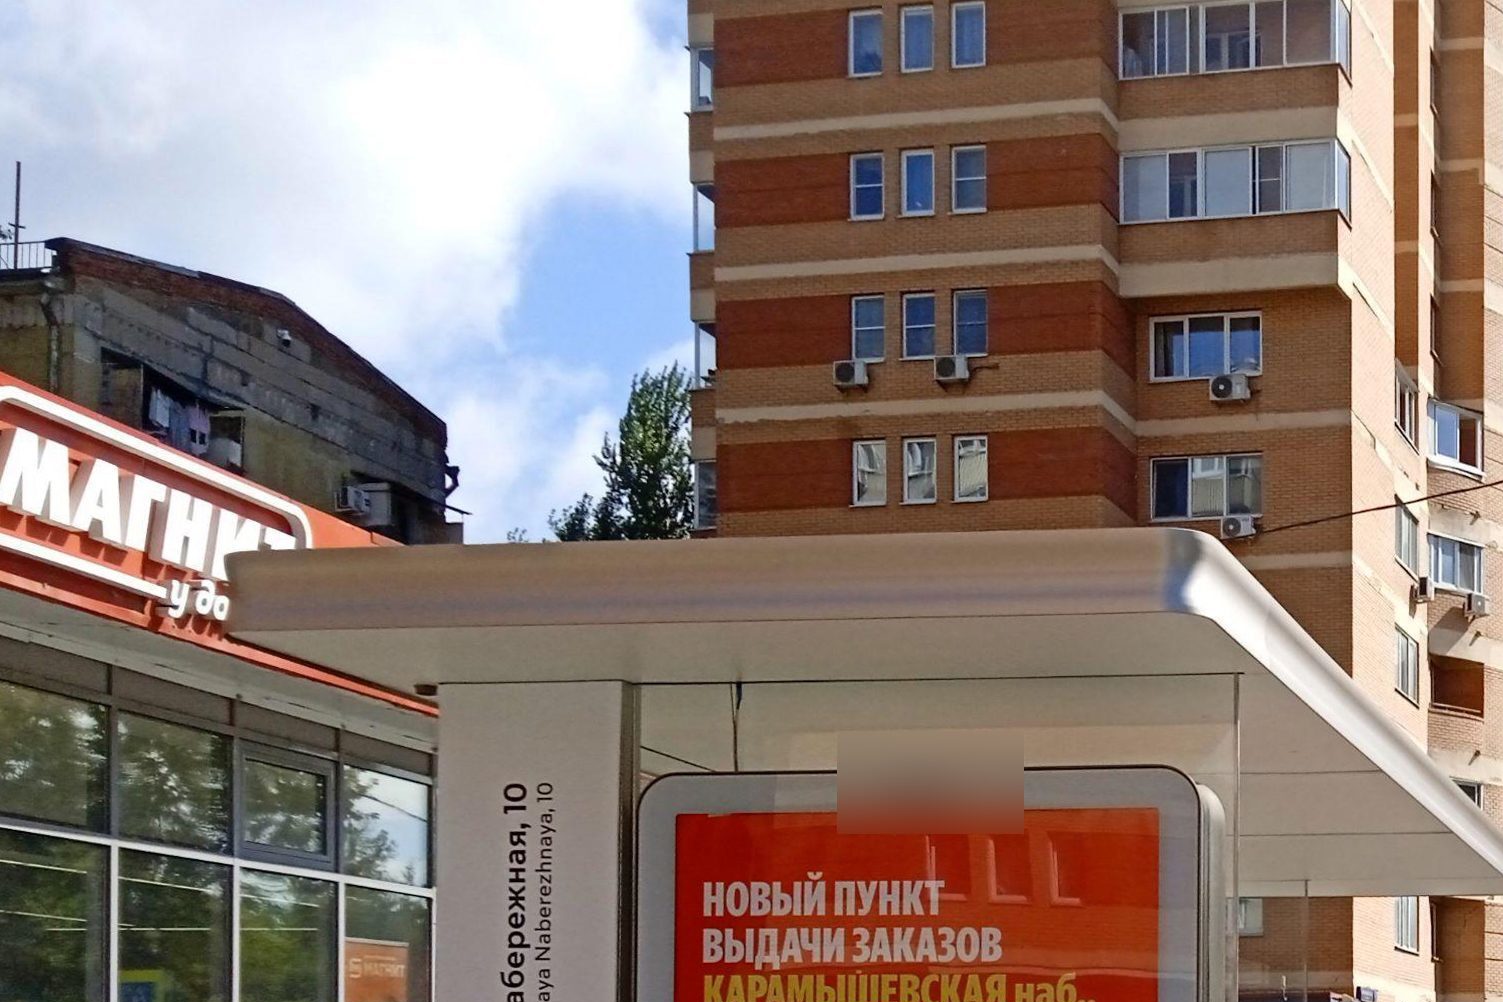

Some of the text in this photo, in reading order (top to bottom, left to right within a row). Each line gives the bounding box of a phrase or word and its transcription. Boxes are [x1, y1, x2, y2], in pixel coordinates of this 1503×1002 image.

[168, 580, 190, 618] у
[503, 783, 528, 814] 10
[537, 782, 554, 803] 10
[535, 808, 556, 961] Naberezhnaya,
[702, 872, 945, 917] НОВЫЙ ПУНКТ
[702, 927, 1002, 970] ВЫДАЧИ ЗАКАЗОВ
